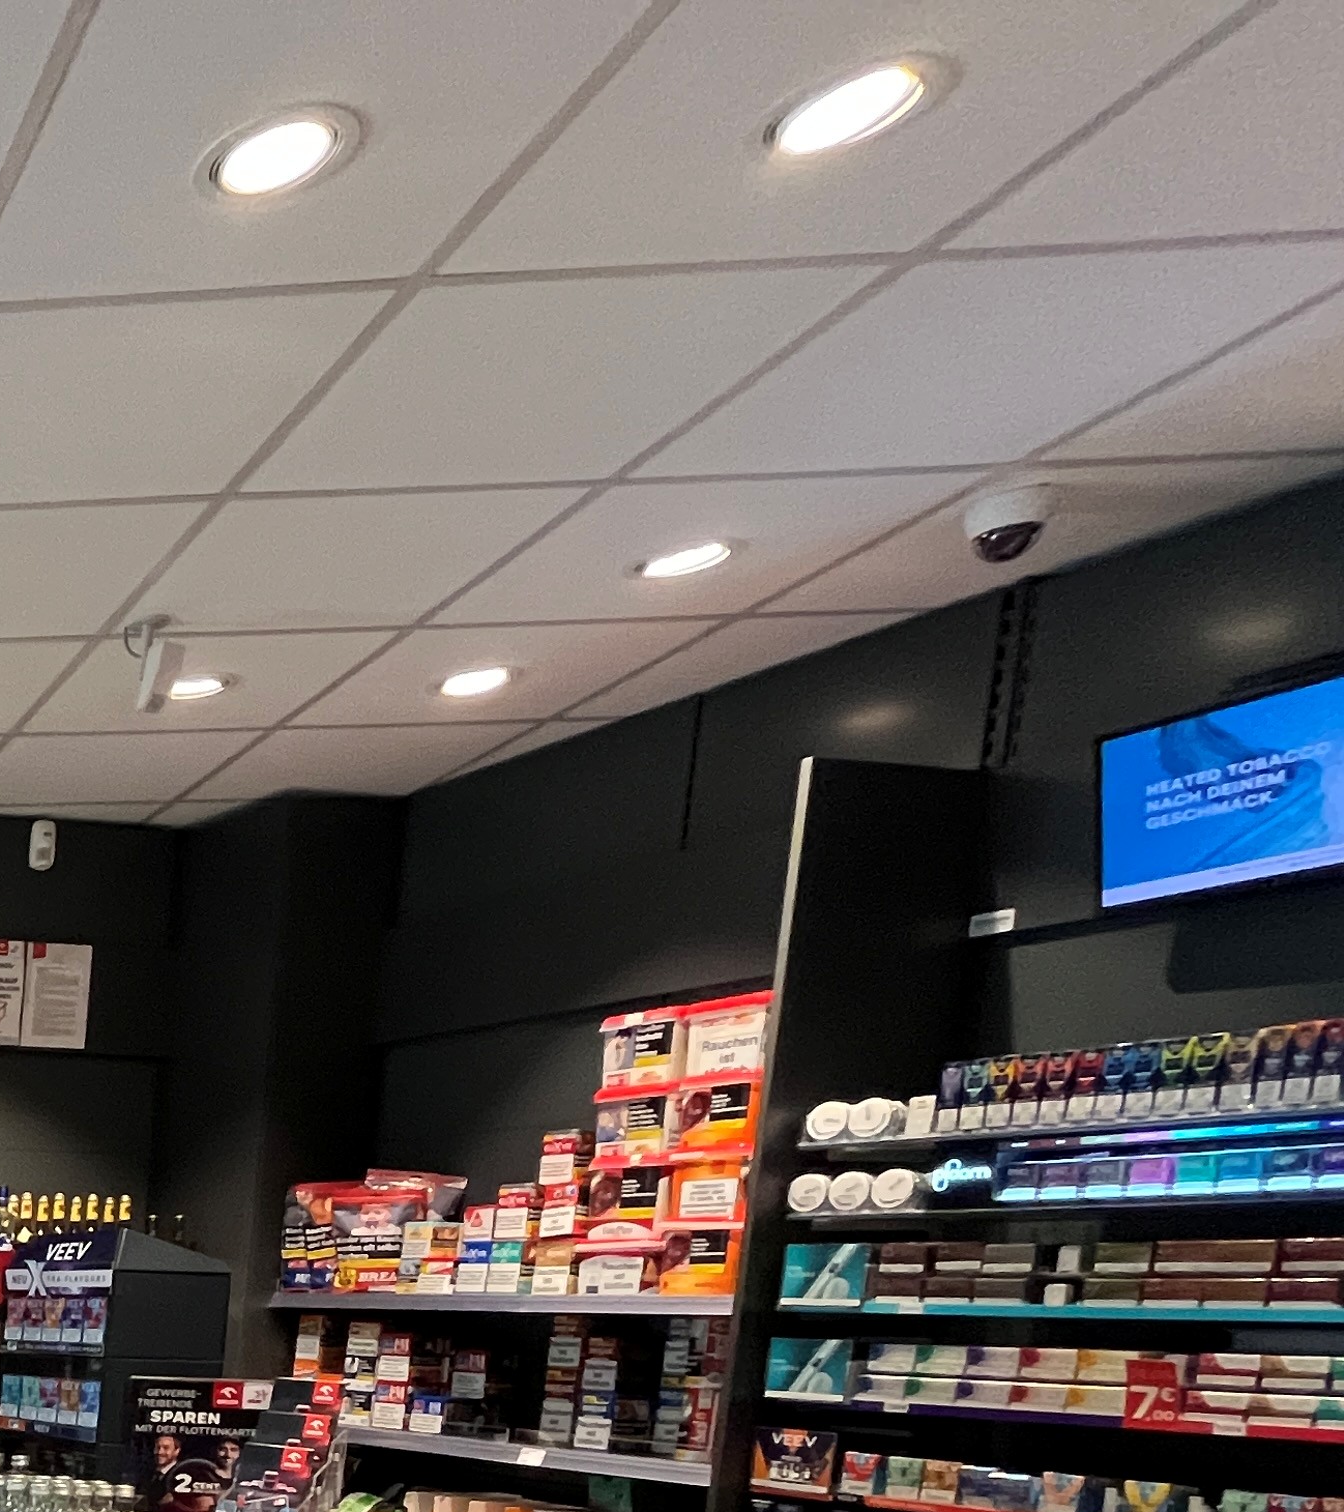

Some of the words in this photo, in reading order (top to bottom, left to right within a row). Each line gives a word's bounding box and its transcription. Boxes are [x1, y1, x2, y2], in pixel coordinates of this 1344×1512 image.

[1145, 767, 1221, 796] HEATED
[1225, 741, 1331, 777] TOBACCO
[1145, 789, 1202, 813] NACH
[1206, 769, 1287, 800] DEINEM
[1145, 790, 1279, 830] GESCHMACK
[702, 1035, 758, 1051] Rauchen
[45, 1240, 93, 1262] VEEV
[150, 1410, 221, 1425] SPAREN
[156, 1424, 178, 1434] DER
[770, 1430, 817, 1448] VEEV
[174, 1473, 192, 1494] 2
